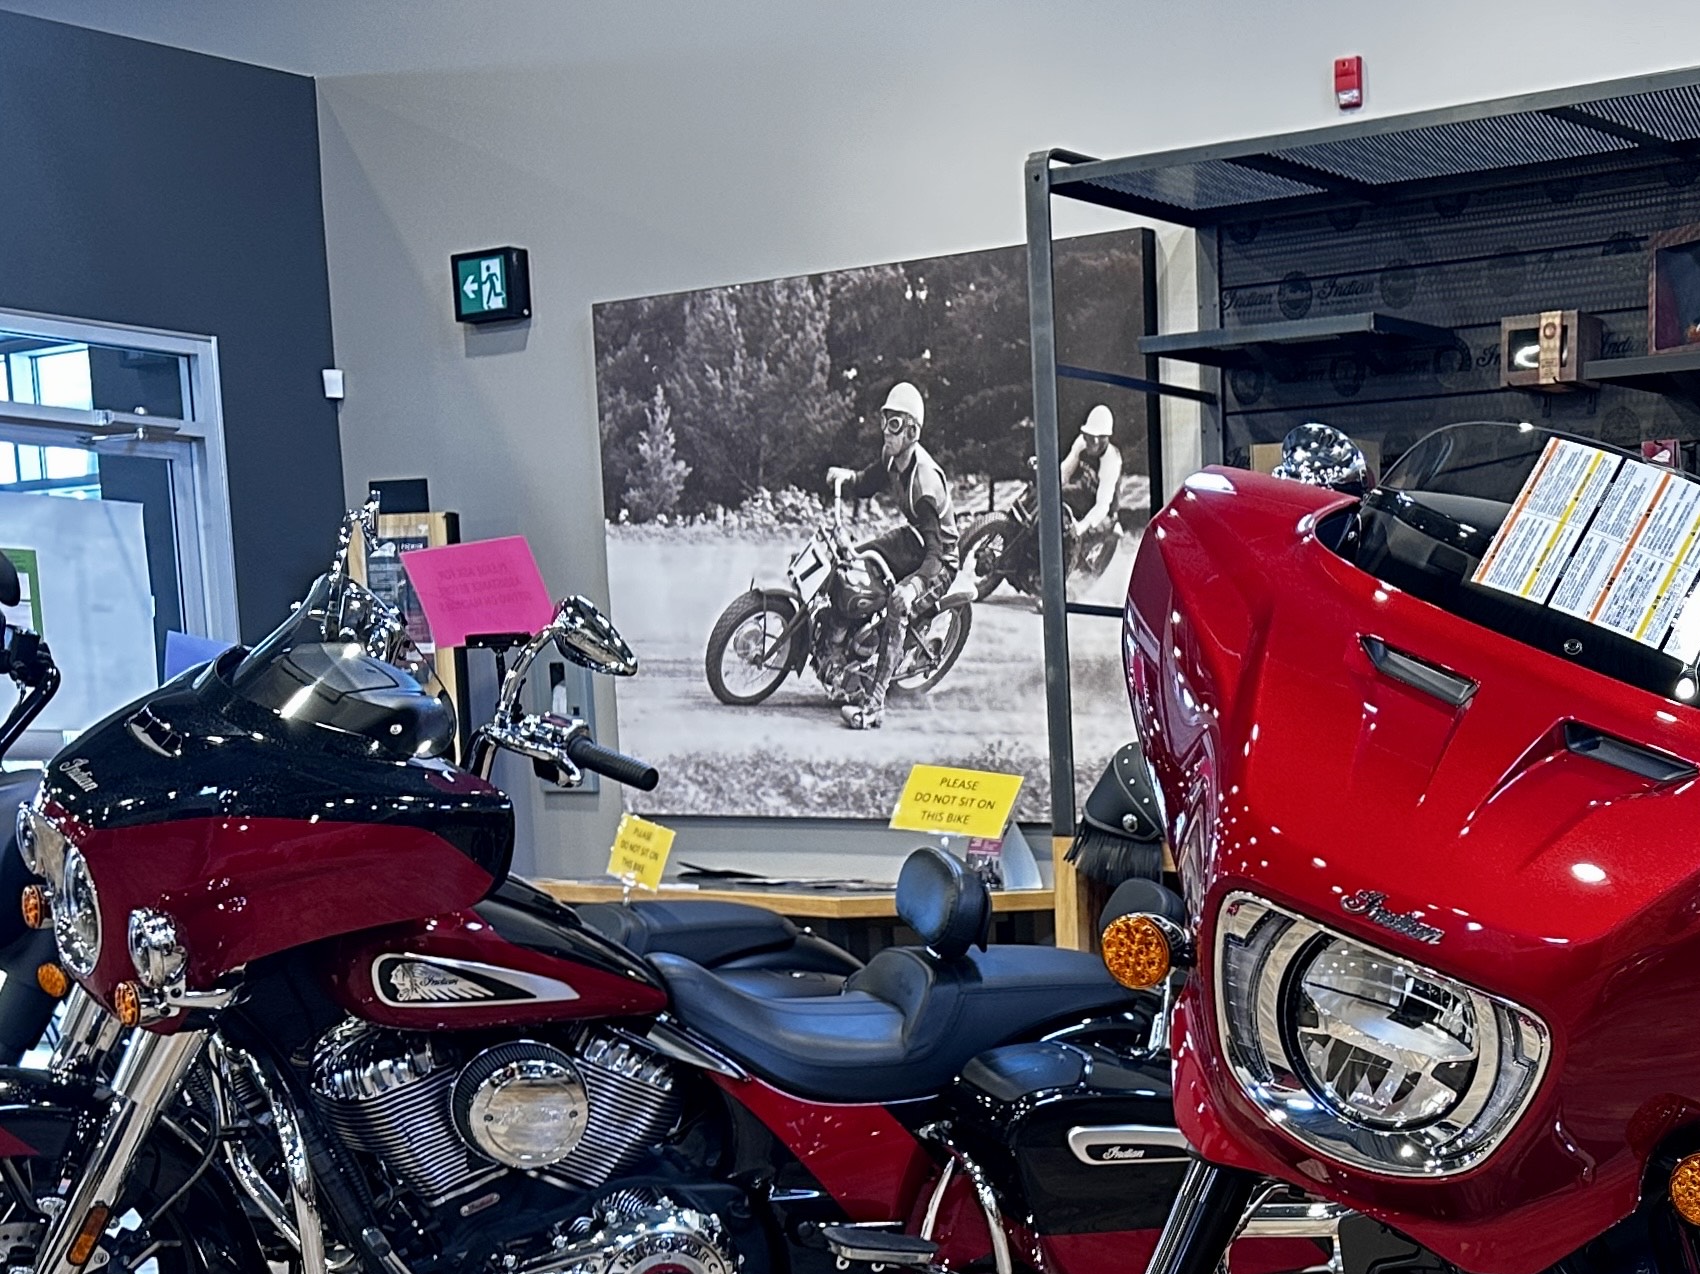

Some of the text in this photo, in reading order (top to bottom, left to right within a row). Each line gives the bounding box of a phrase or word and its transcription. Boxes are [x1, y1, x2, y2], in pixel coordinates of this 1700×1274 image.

[59, 758, 98, 792] Indian
[939, 776, 980, 791] PLEASE
[914, 792, 996, 810] DO NOT SIT ON
[921, 810, 970, 825] THIS BIKE
[1341, 889, 1445, 945] Indian
[420, 976, 459, 987] Indian
[1102, 1145, 1145, 1160] Indian
